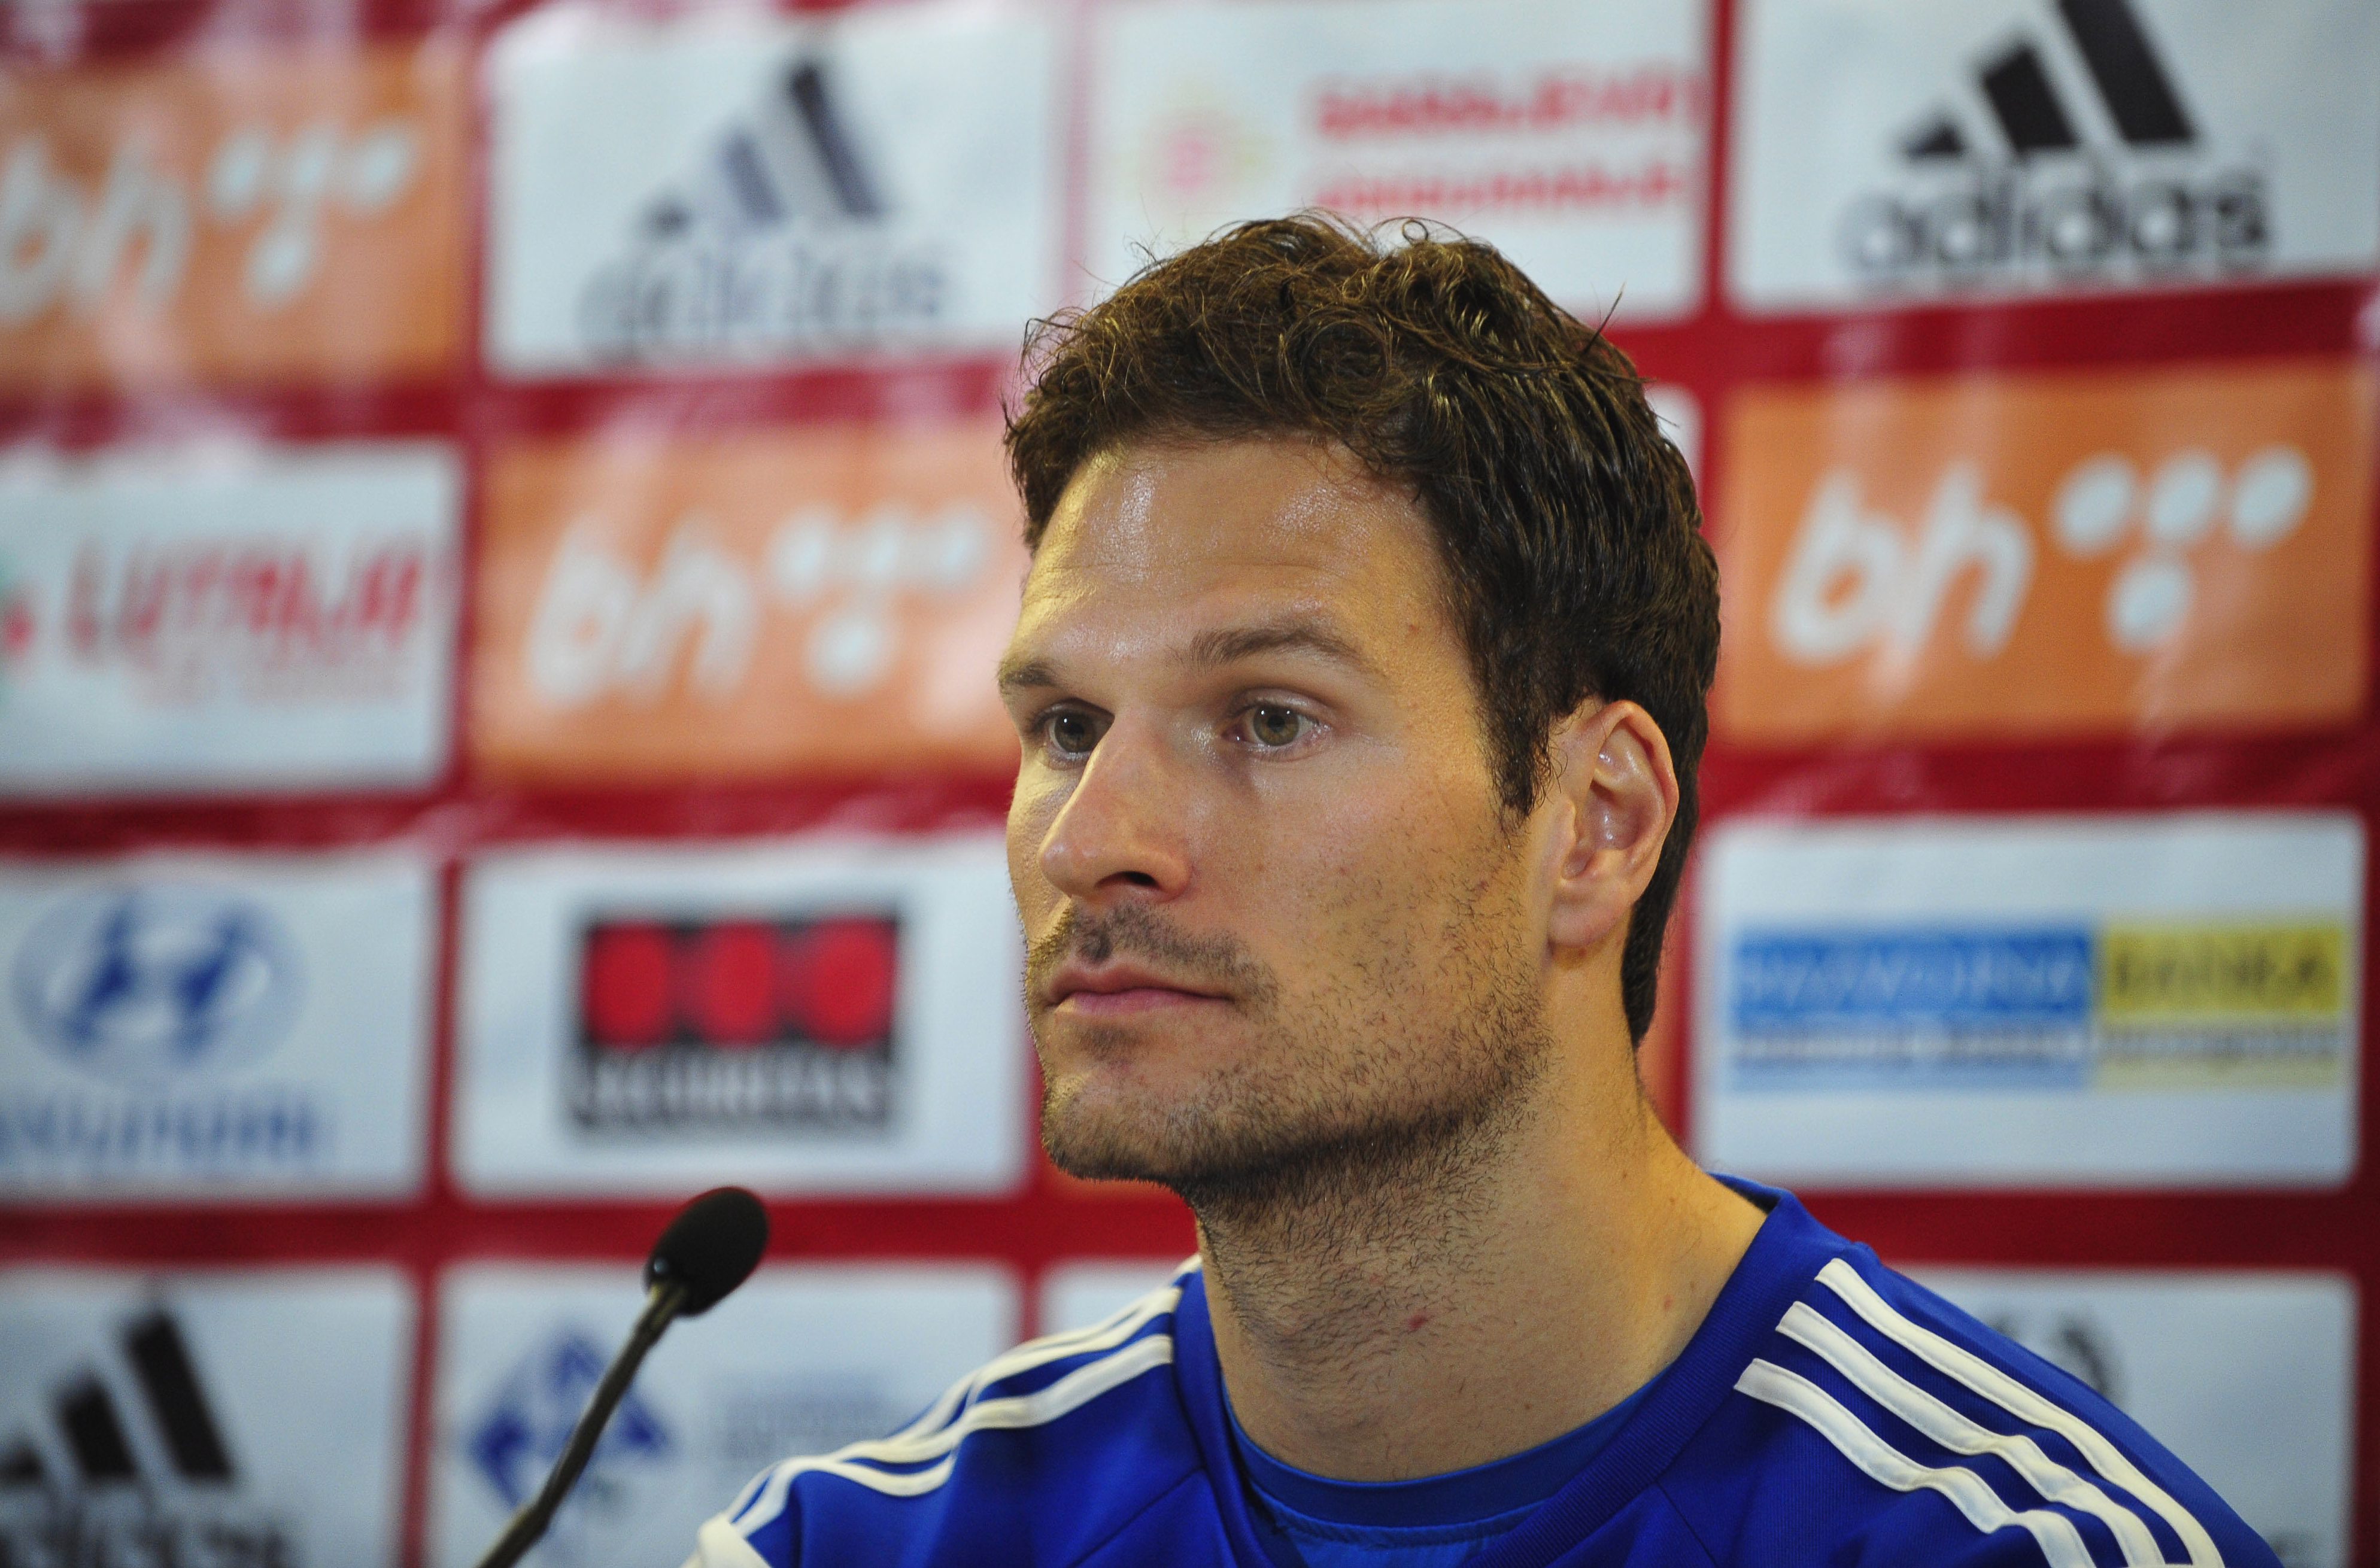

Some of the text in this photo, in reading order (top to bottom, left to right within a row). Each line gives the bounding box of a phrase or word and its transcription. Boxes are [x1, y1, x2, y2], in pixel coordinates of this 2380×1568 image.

[1839, 159, 2269, 287] adidas
[526, 503, 757, 706] bh
[1773, 458, 2032, 667] bh
